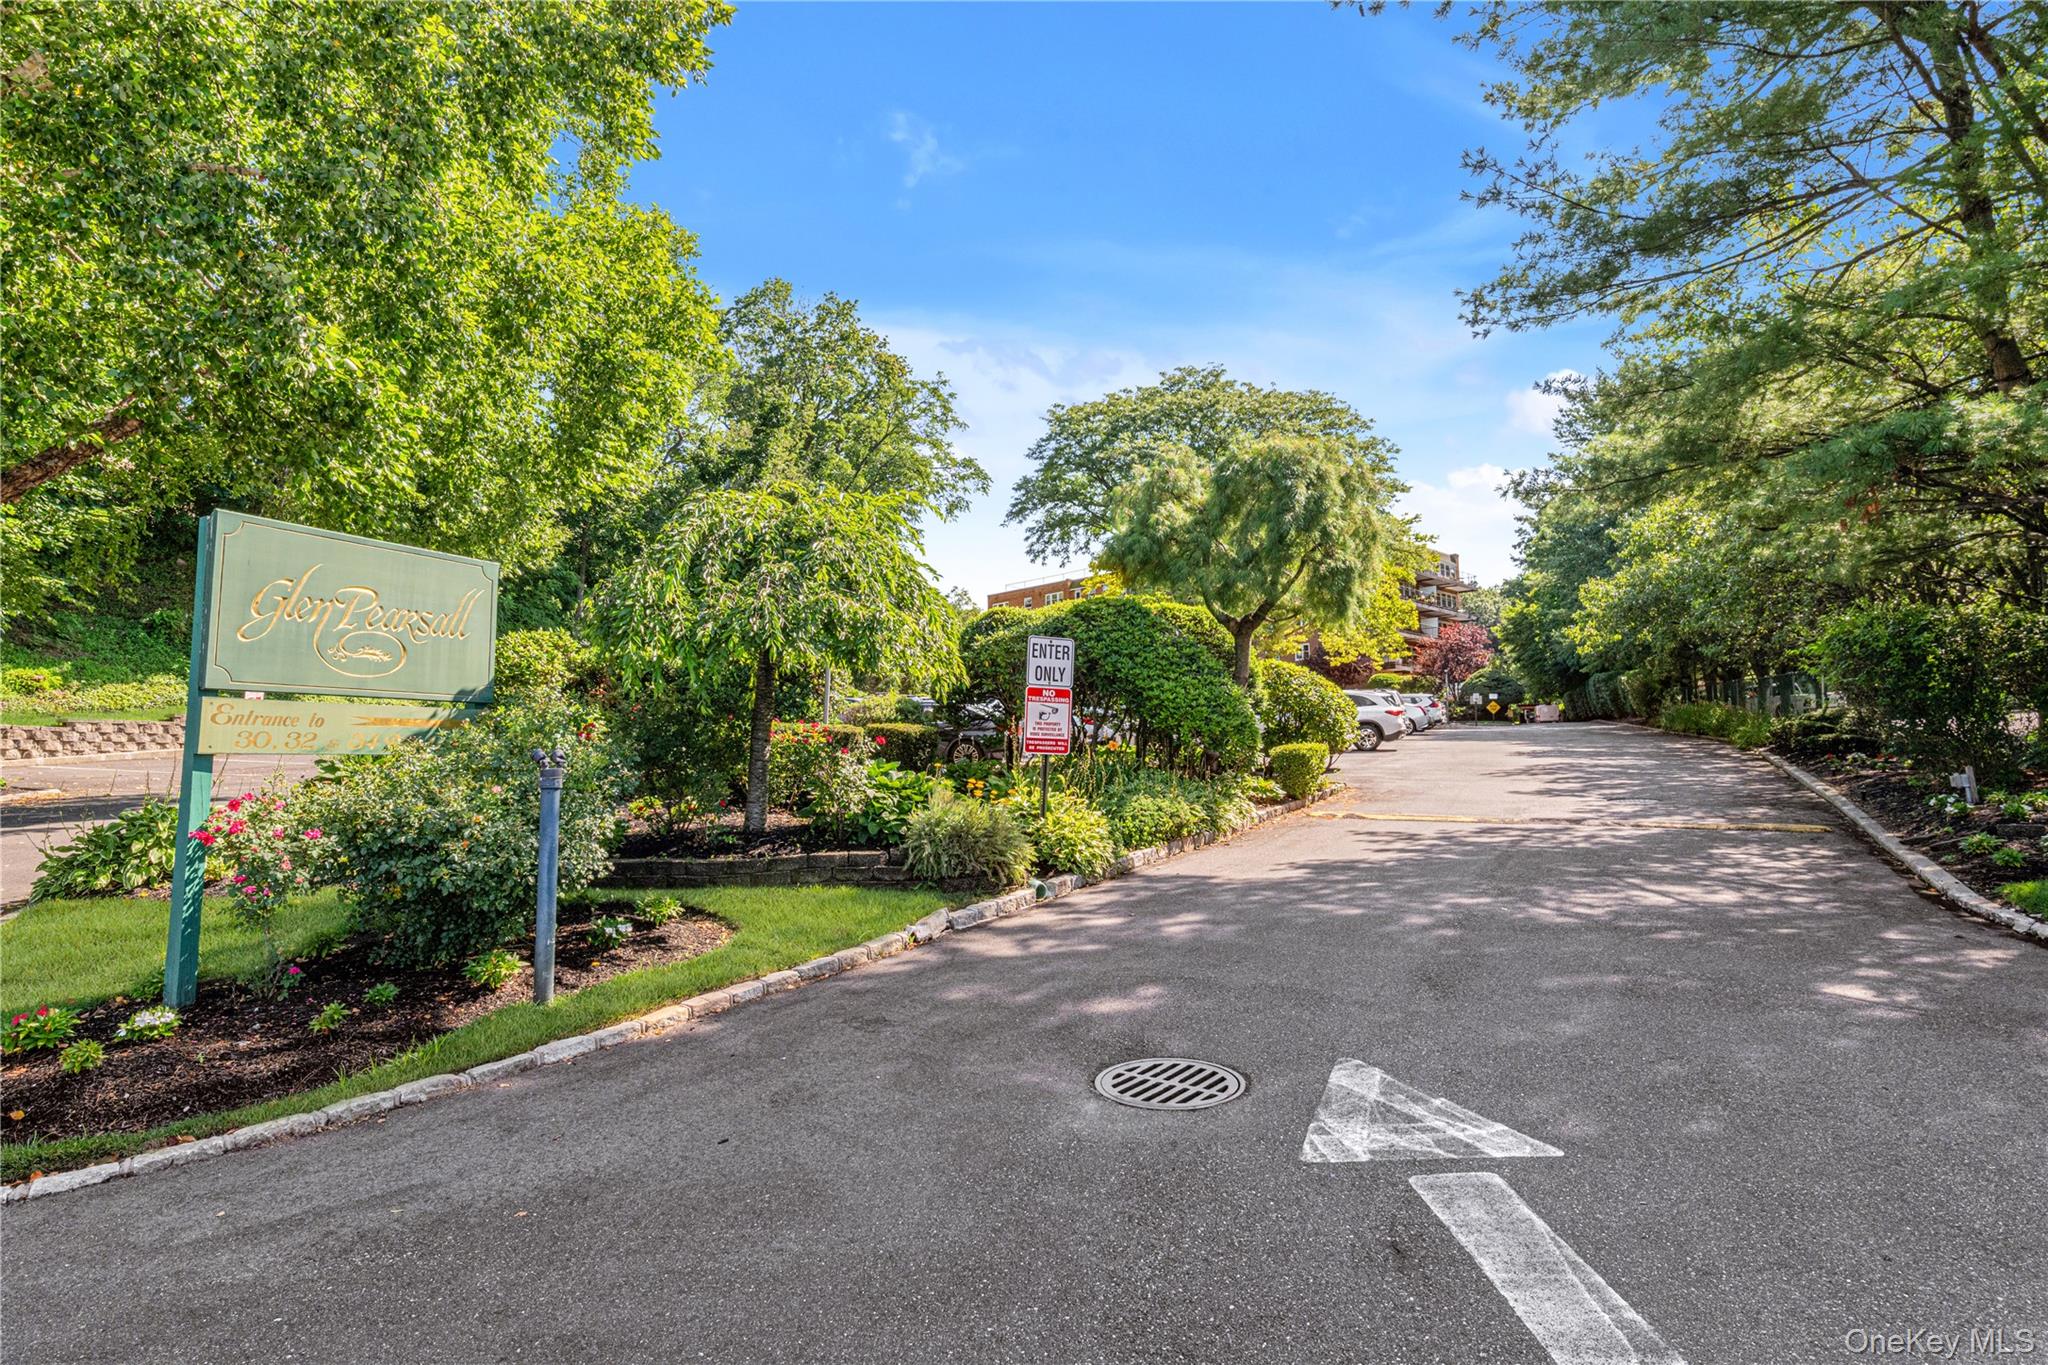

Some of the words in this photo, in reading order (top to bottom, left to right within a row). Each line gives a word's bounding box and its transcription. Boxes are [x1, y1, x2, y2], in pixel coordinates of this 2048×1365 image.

[237, 563, 336, 660] Glen
[332, 585, 486, 645] Pearsall
[1032, 643, 1070, 660] ENTER
[1035, 665, 1066, 682] ONLY
[1042, 689, 1056, 697] NO
[210, 703, 300, 727] Entrance
[308, 713, 325, 728] to
[284, 731, 318, 750] 32
